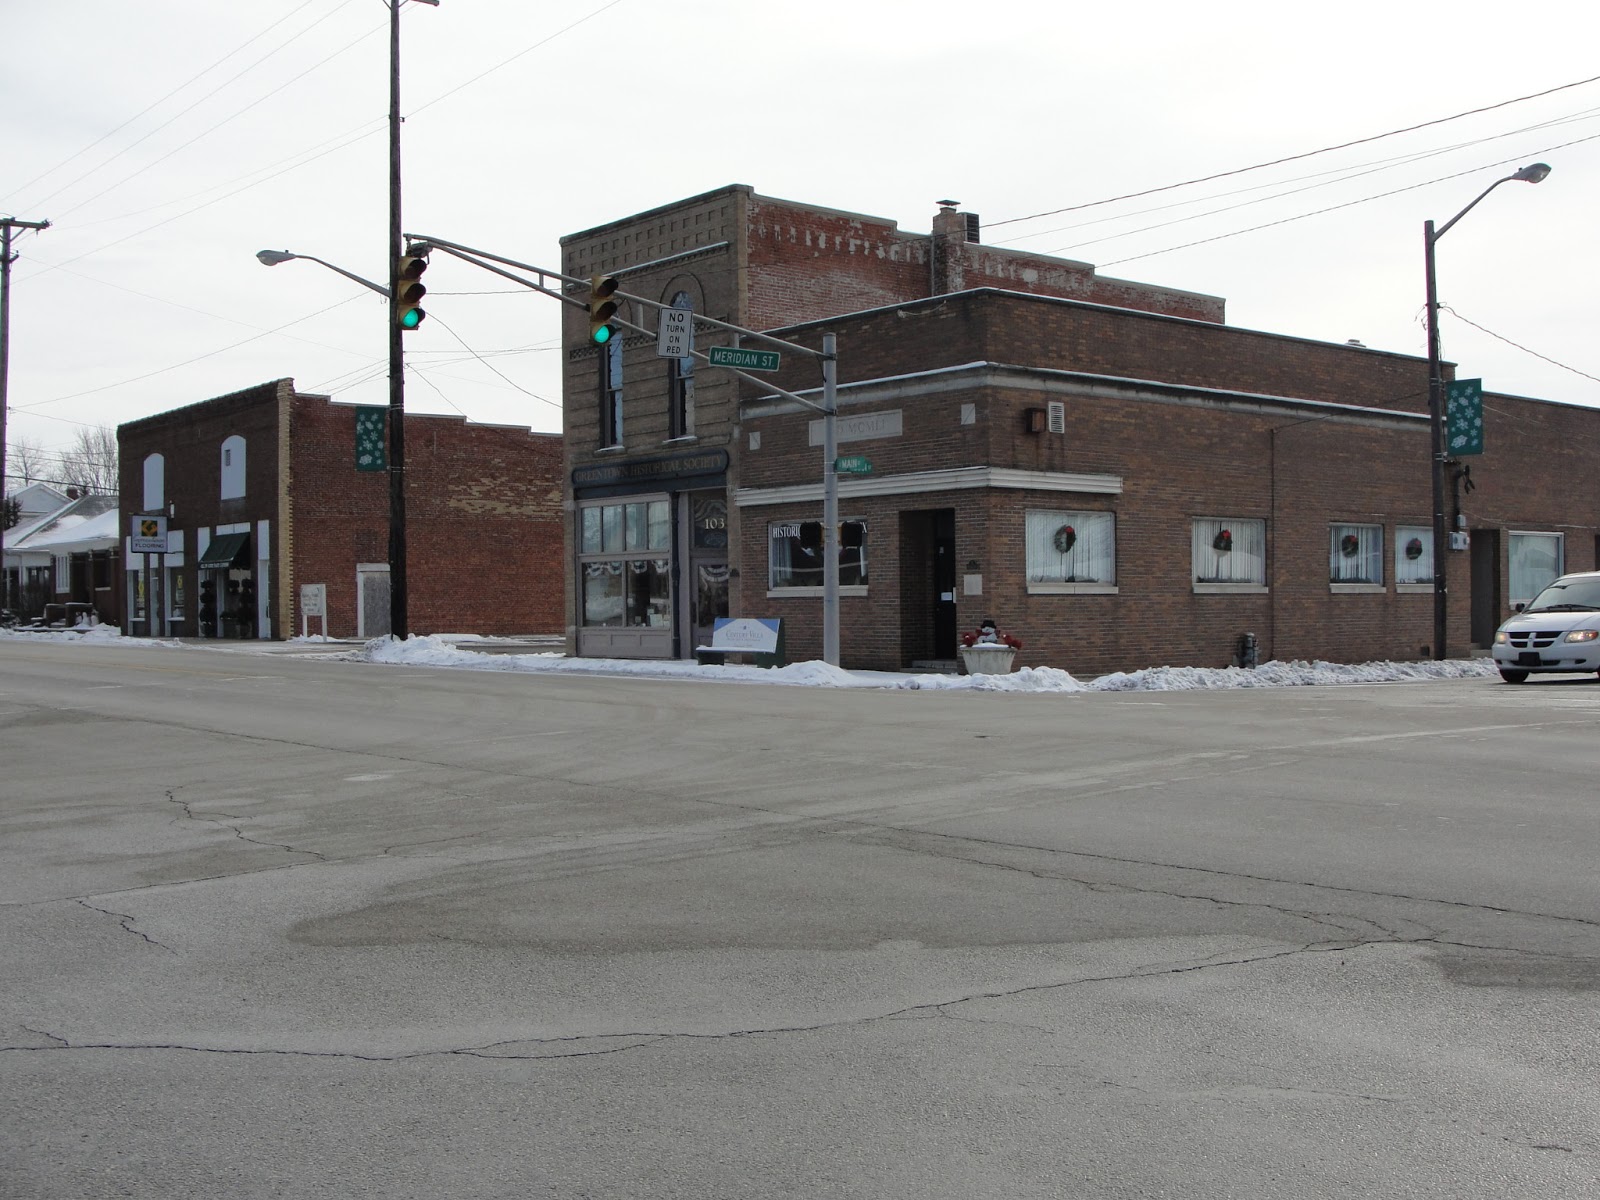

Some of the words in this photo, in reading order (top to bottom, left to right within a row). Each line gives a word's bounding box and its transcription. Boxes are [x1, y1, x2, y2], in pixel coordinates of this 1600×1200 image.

[669, 312, 684, 323] NO
[666, 325, 685, 333] TURN
[666, 346, 681, 354] RED
[714, 351, 758, 366] MERIDIAN
[683, 456, 722, 470] SOCIETY
[841, 459, 858, 468] MAIN
[704, 518, 725, 529] 103
